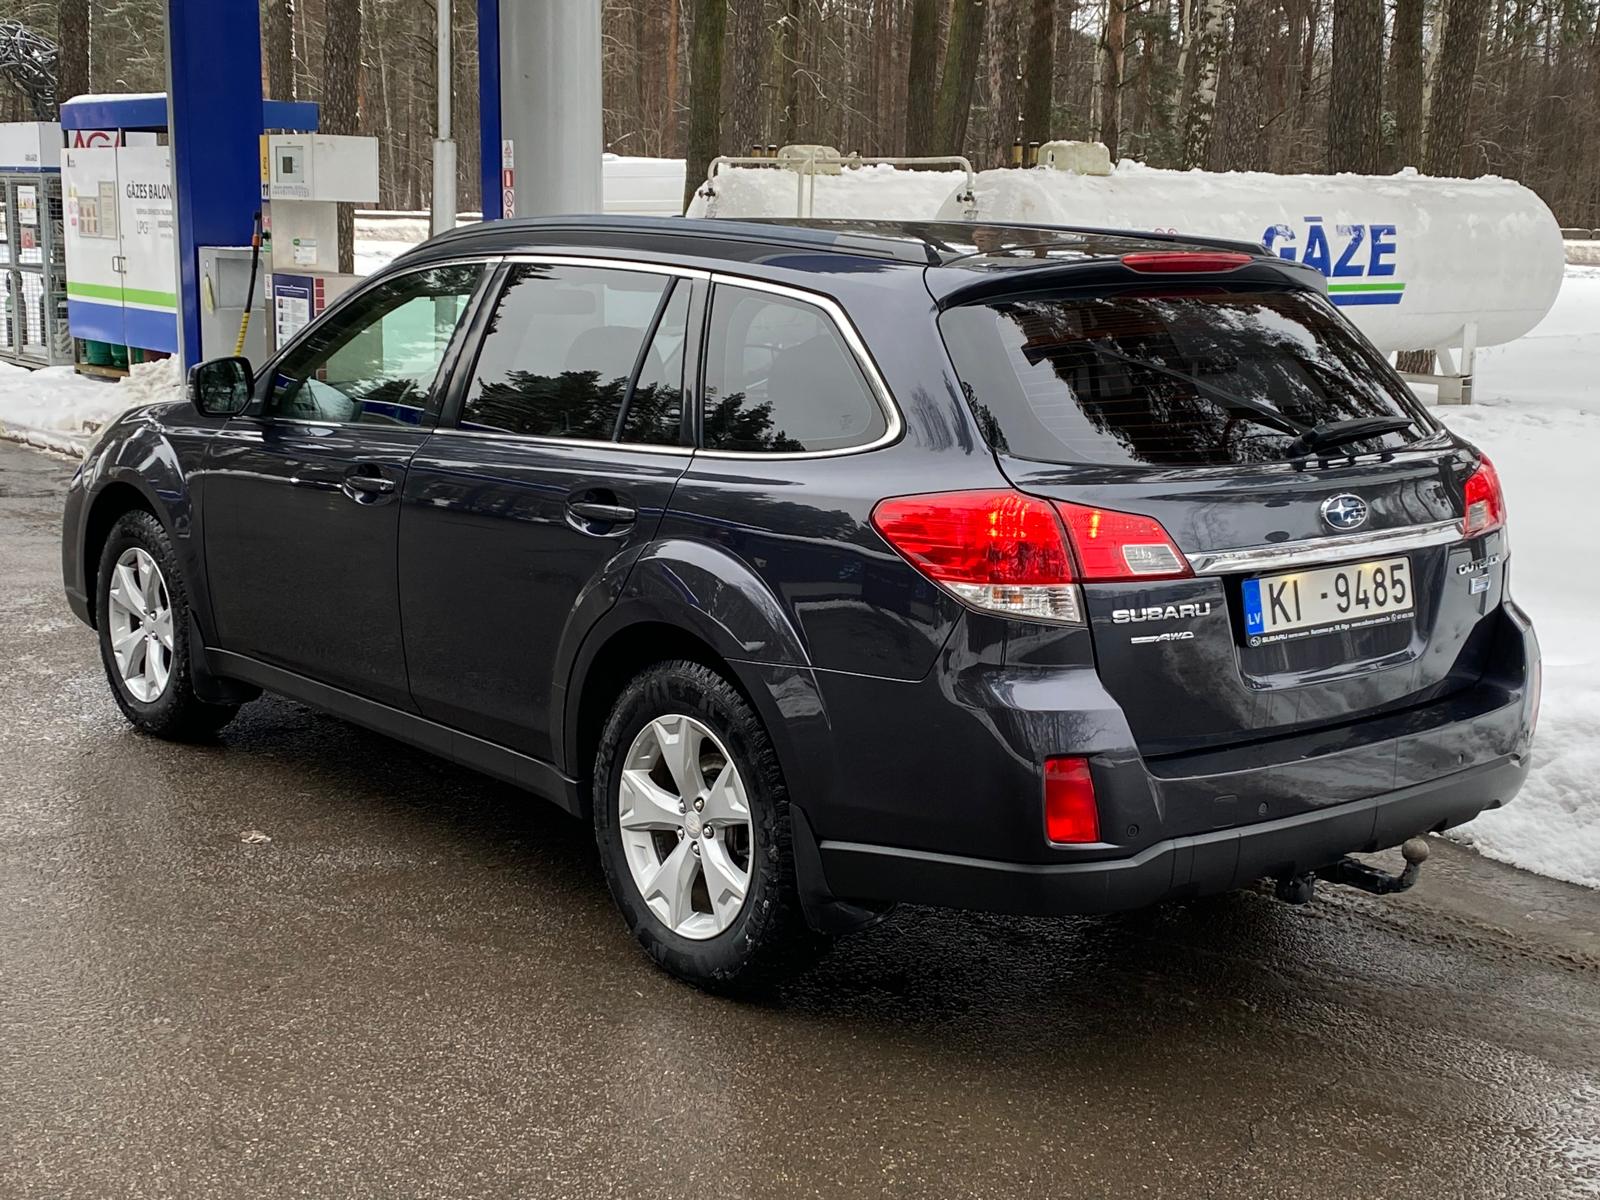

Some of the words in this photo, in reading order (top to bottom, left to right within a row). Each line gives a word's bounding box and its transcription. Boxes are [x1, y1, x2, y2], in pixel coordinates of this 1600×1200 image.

[74, 129, 121, 148] AG
[126, 180, 147, 199] GĀZES
[1262, 216, 1397, 277] GĀZE
[1112, 602, 1210, 624] SUBARU
[1247, 612, 1261, 626] LV
[1152, 631, 1195, 642] AWD
